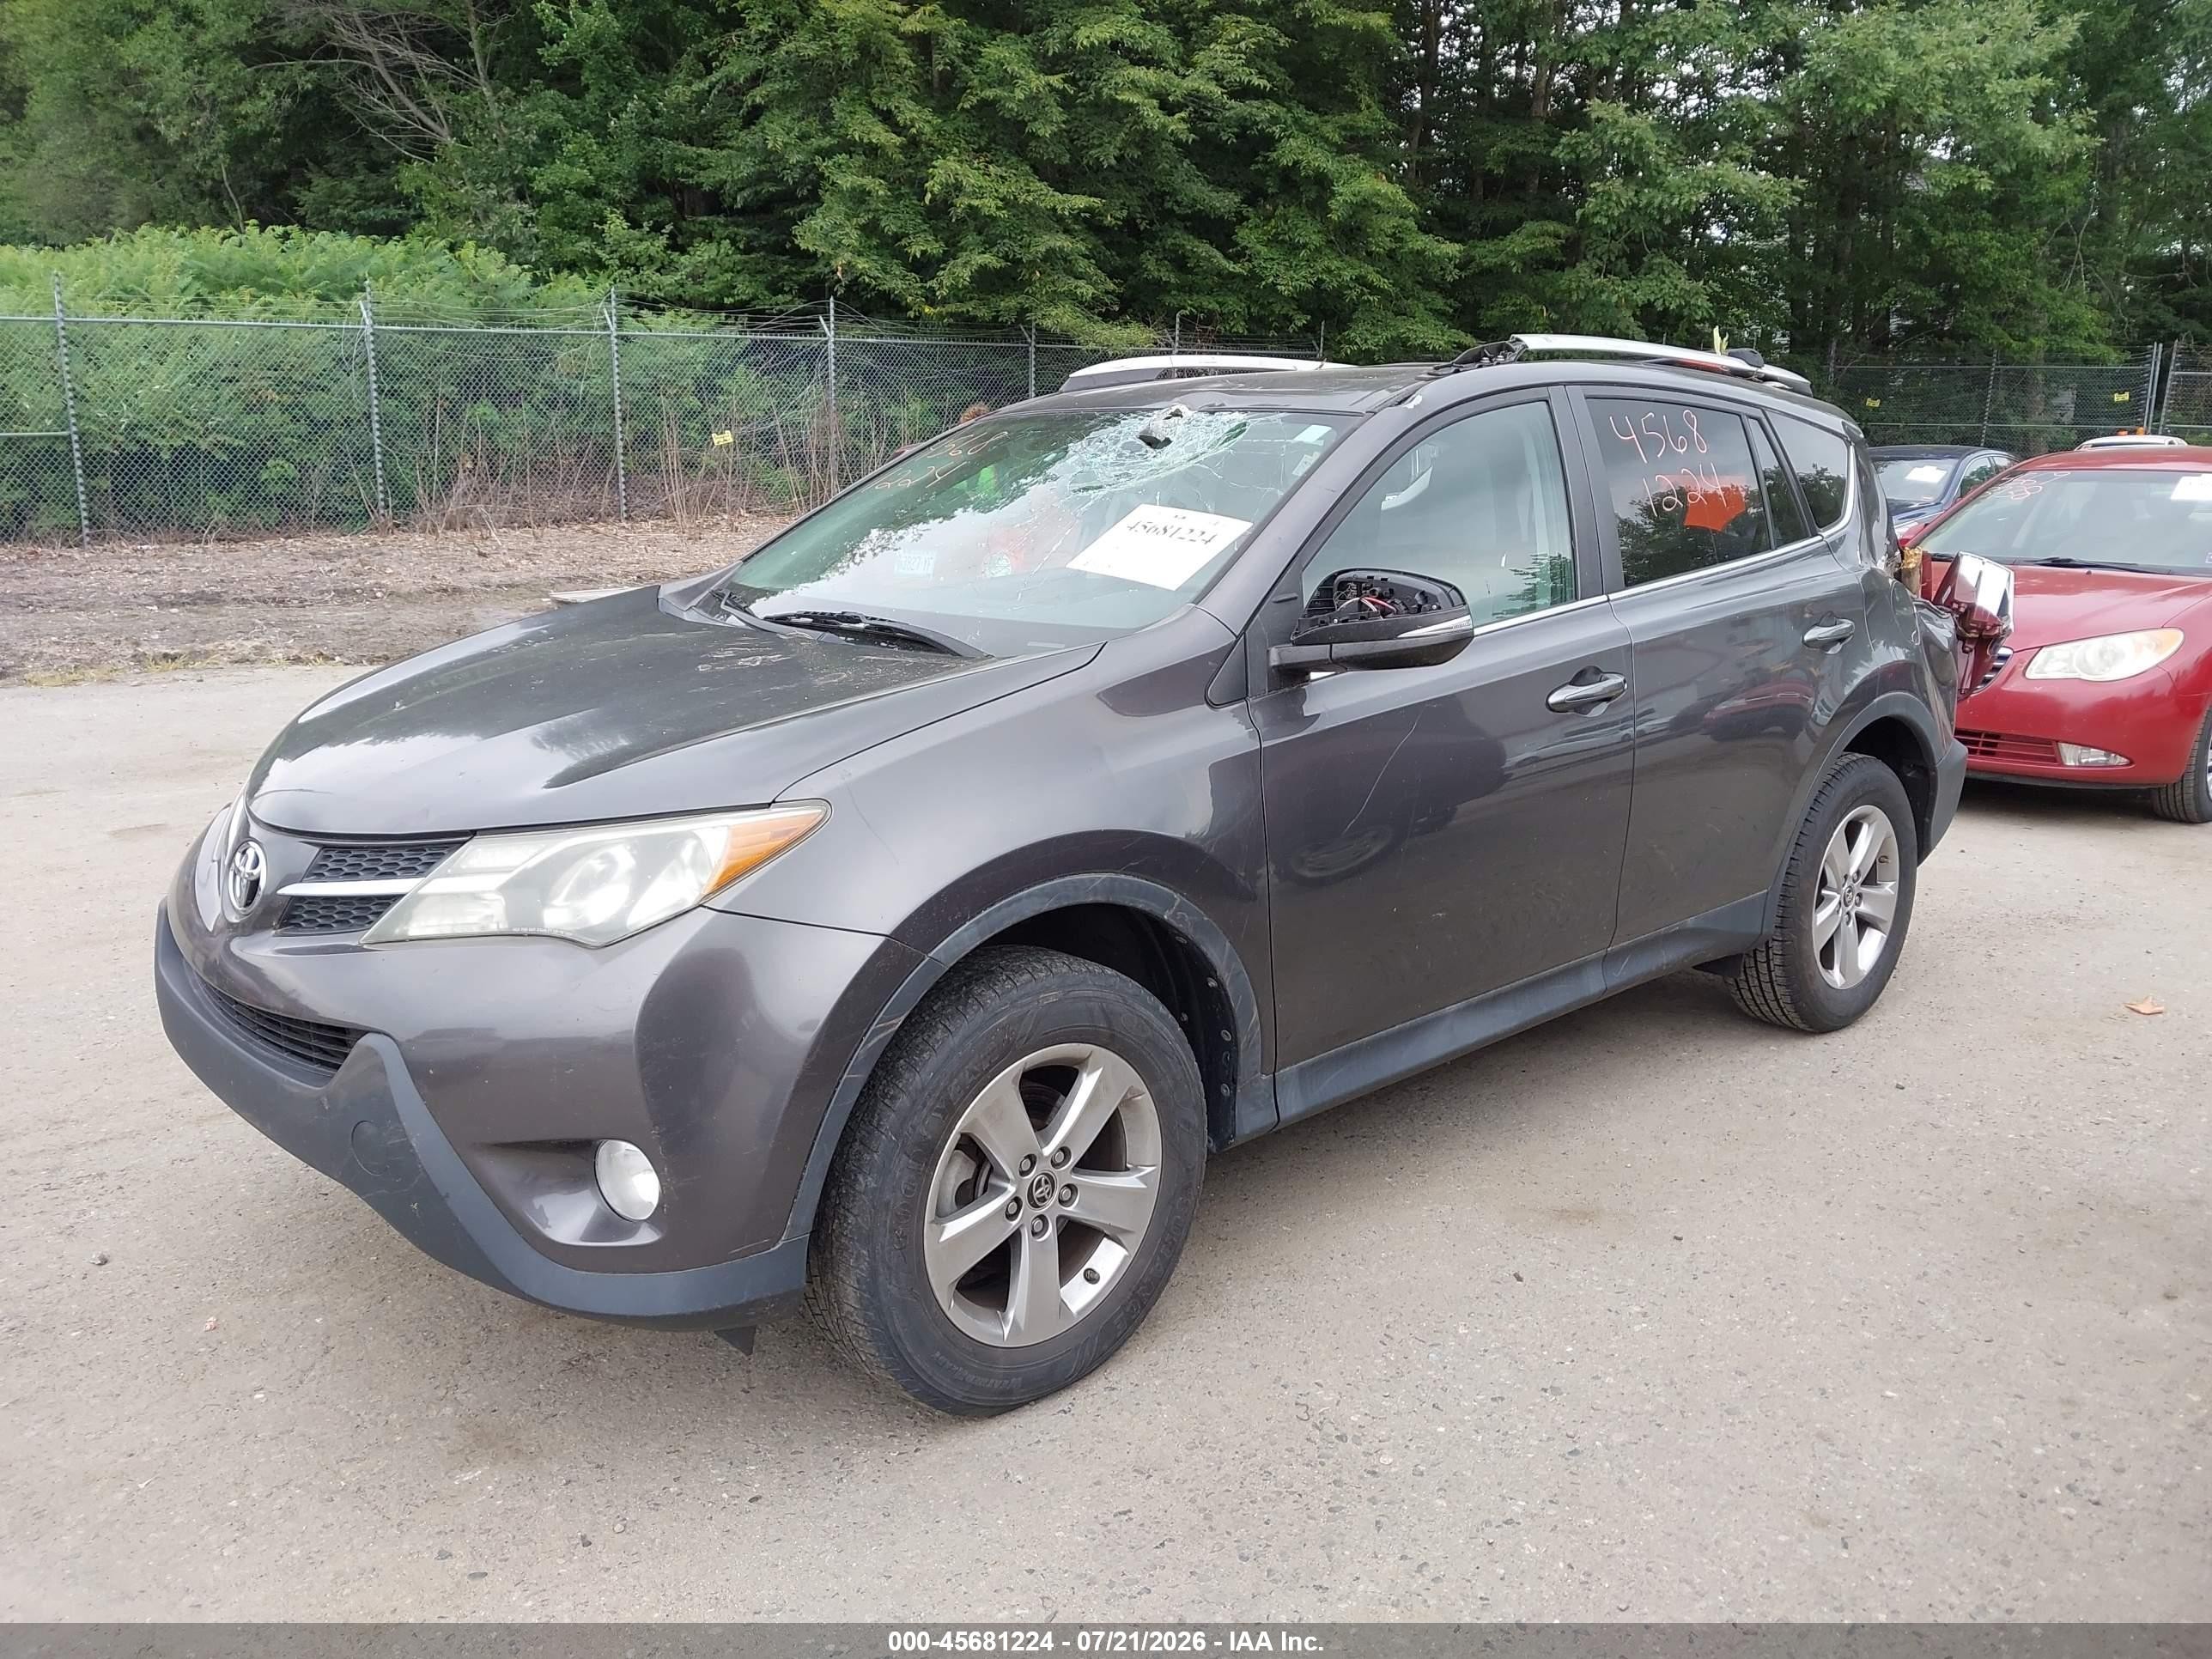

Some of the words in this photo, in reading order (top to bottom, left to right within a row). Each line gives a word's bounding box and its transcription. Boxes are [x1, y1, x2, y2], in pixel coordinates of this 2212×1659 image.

[1609, 409, 1707, 465] 4568
[1642, 461, 1729, 518] 1224
[1127, 520, 1218, 545] 45681224
